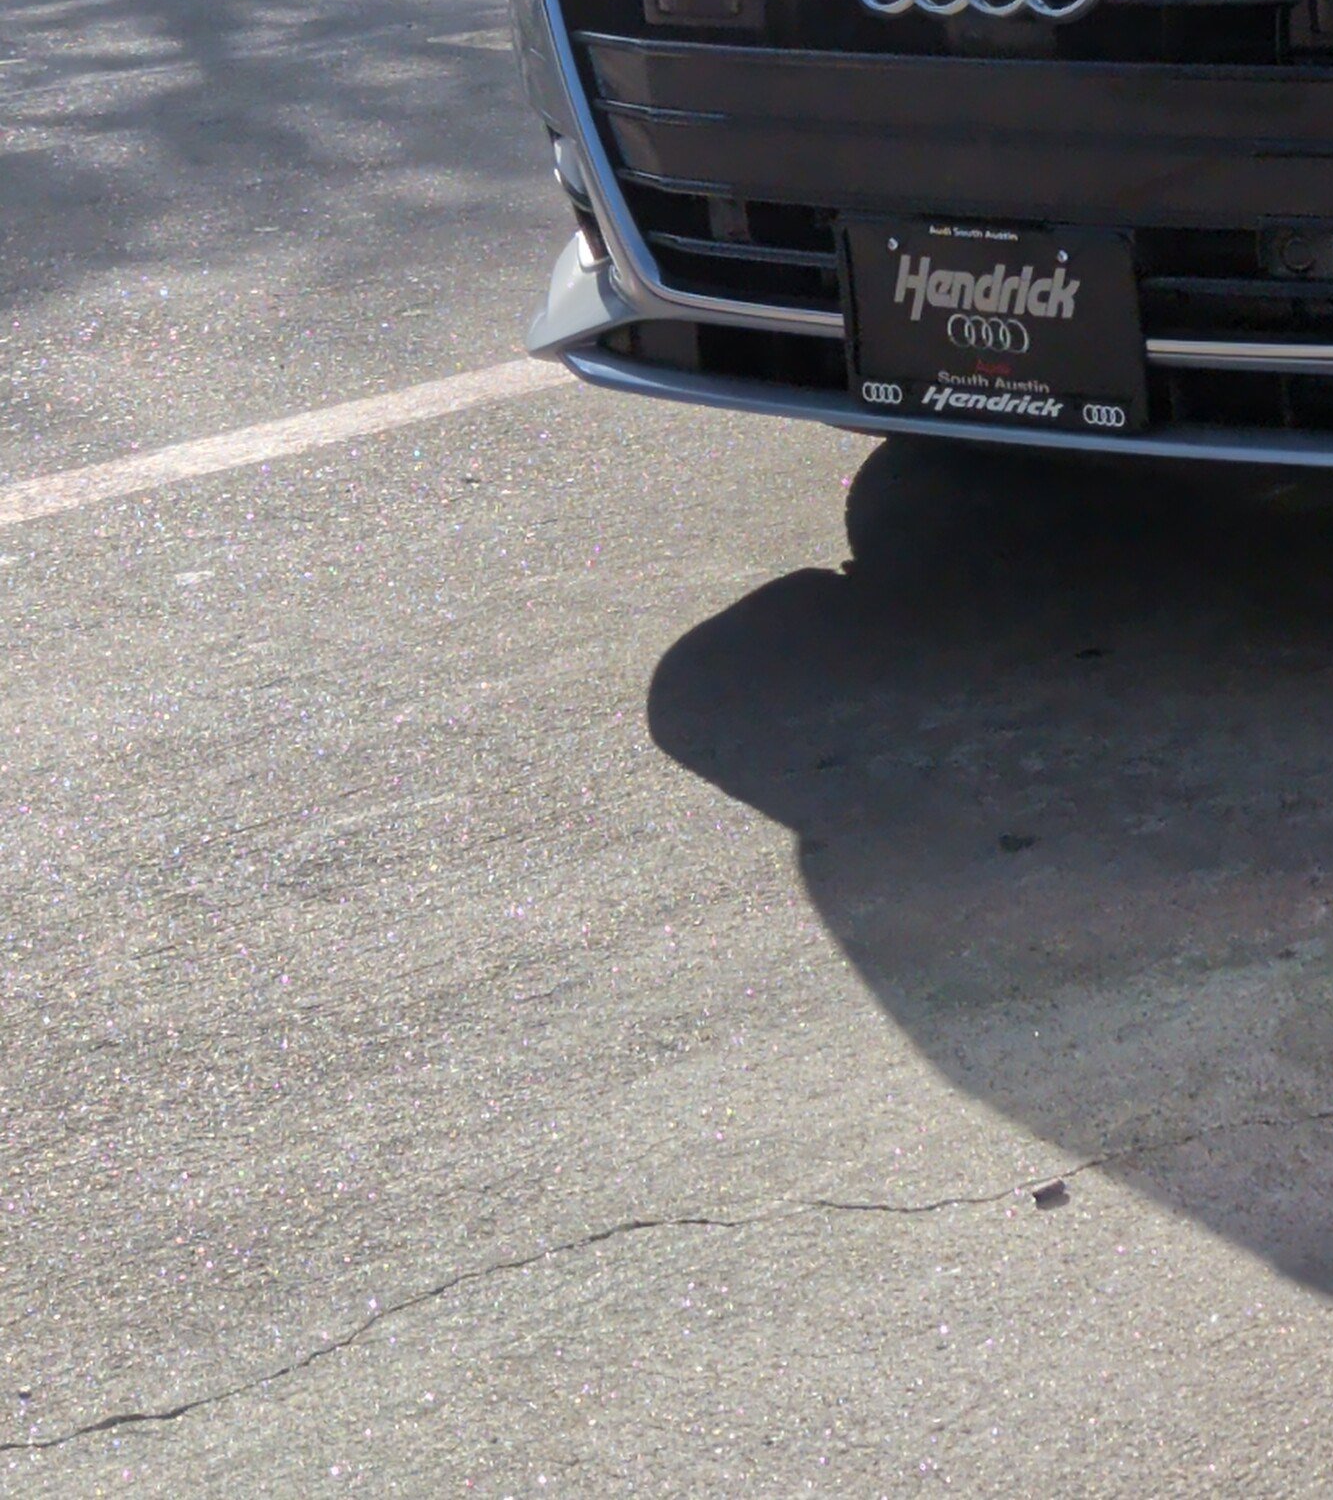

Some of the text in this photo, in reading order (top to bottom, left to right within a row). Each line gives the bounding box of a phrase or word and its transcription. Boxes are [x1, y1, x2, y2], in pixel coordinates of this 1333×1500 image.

[929, 225, 1018, 241] Audi South Austin
[894, 254, 1081, 321] Hendrick
[937, 370, 1050, 394] South Austin
[921, 386, 1064, 418] Hendrick
